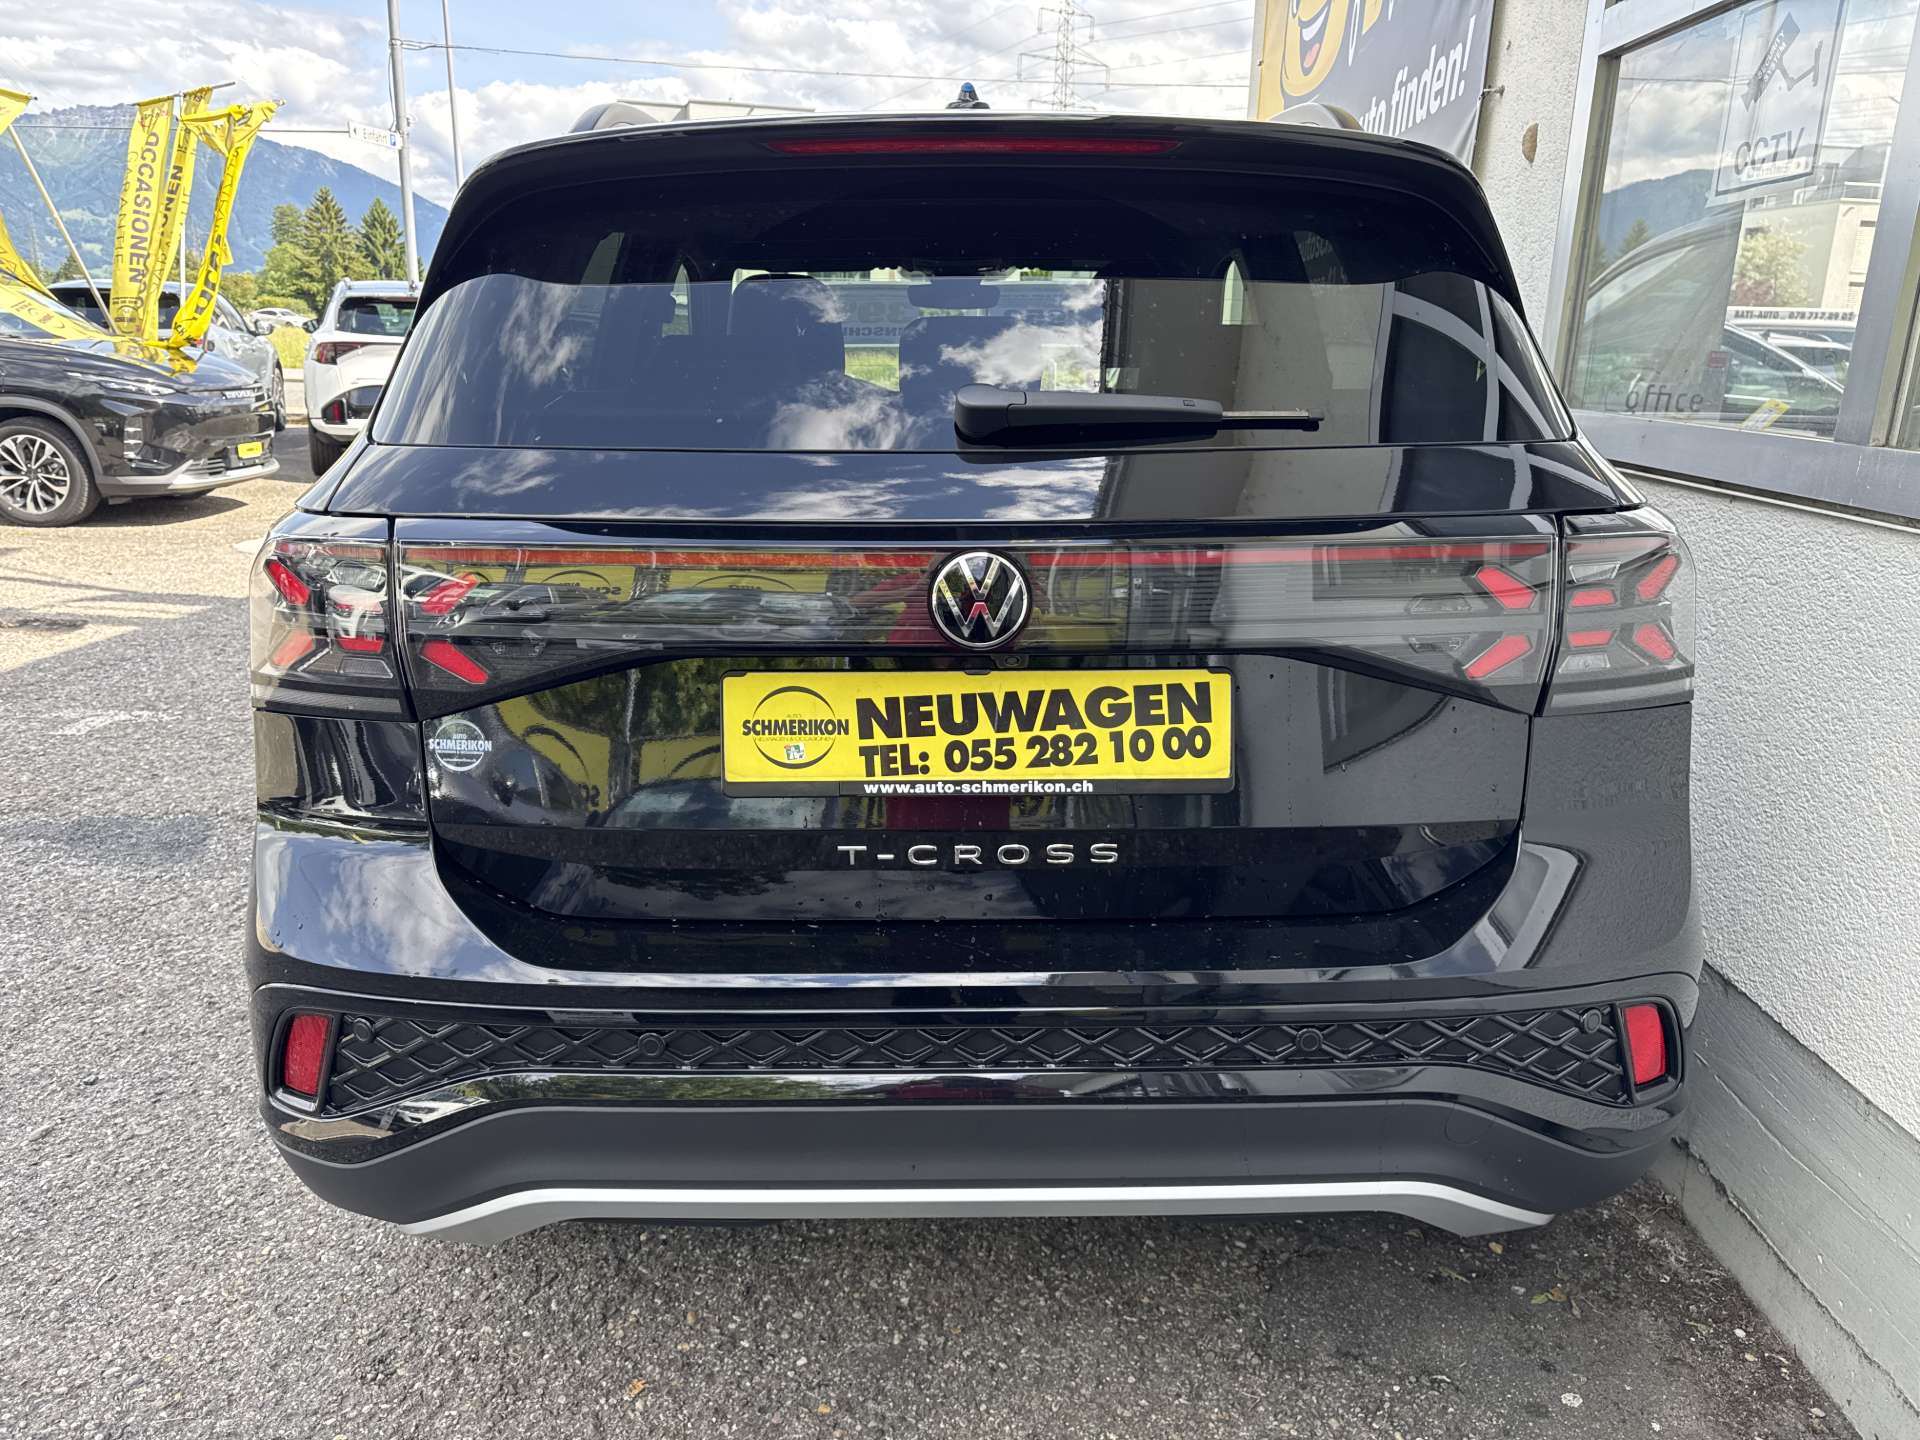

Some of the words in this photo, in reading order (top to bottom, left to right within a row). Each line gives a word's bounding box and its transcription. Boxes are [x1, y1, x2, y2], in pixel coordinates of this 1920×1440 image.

[1360, 96, 1386, 136] uto
[1389, 15, 1476, 137] finden!
[1734, 127, 1805, 176] CCTV
[1625, 384, 1704, 413] office
[855, 681, 1213, 740] NEUWAGEN
[742, 718, 849, 736] SCHMERIKON
[429, 738, 492, 751] SCHMERIKON
[858, 744, 930, 778] TEL:
[944, 738, 1015, 773] 055
[1026, 733, 1099, 769] 282
[1109, 729, 1151, 764] 10
[1161, 726, 1212, 759] 00
[863, 780, 1094, 794] www.auto-schmerikon.ch
[837, 843, 1120, 865] T-CROSS
